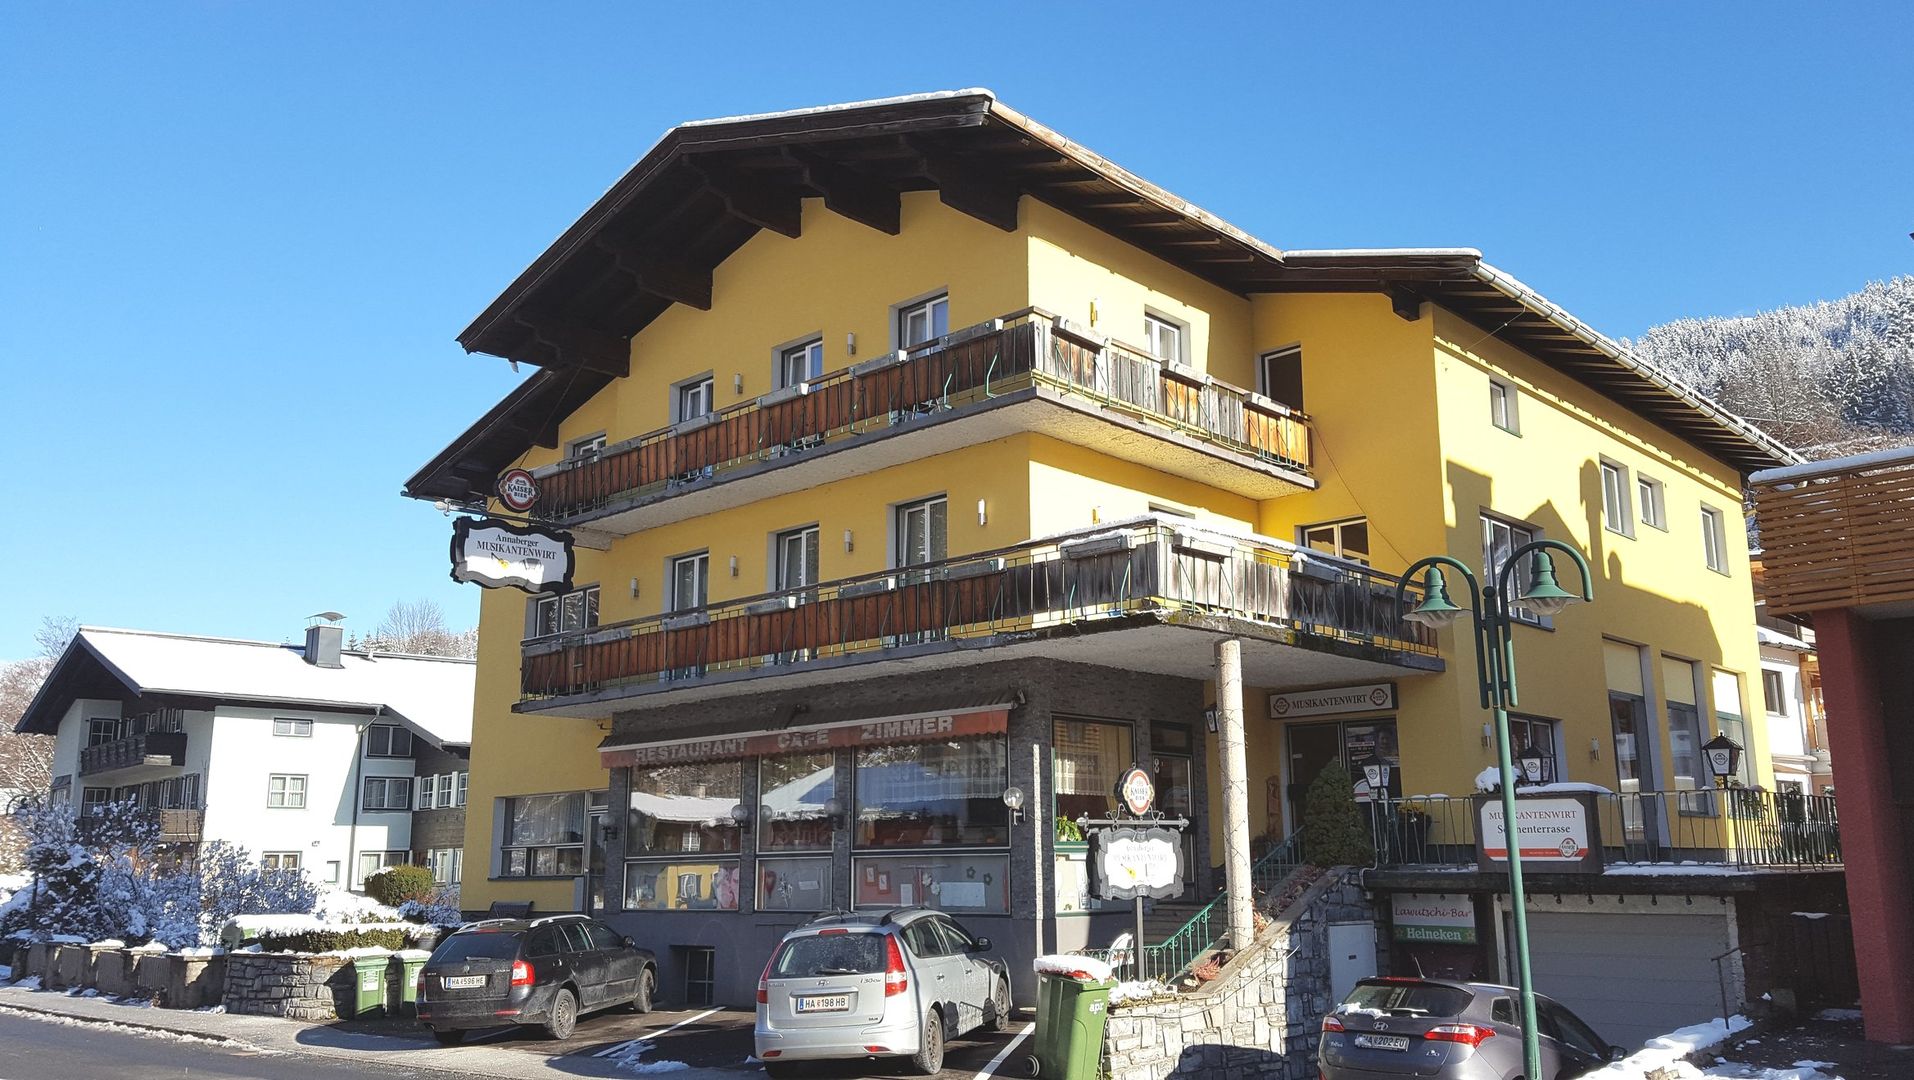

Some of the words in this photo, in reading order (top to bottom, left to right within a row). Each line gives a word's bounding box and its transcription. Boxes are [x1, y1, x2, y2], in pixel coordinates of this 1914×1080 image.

[507, 484, 533, 496] KAISER
[513, 491, 528, 499] BIER
[496, 534, 539, 547] Annaberger
[477, 540, 557, 559] MUSIKANTENWIRT
[1291, 694, 1367, 710] MUSIKANTENWIRT
[635, 738, 749, 764] RESTAURANT
[860, 716, 953, 740] ZIMMER
[1407, 927, 1462, 941] Heineken
[805, 999, 816, 1008] HA
[821, 998, 835, 1008] 198
[835, 997, 846, 1007] HB
